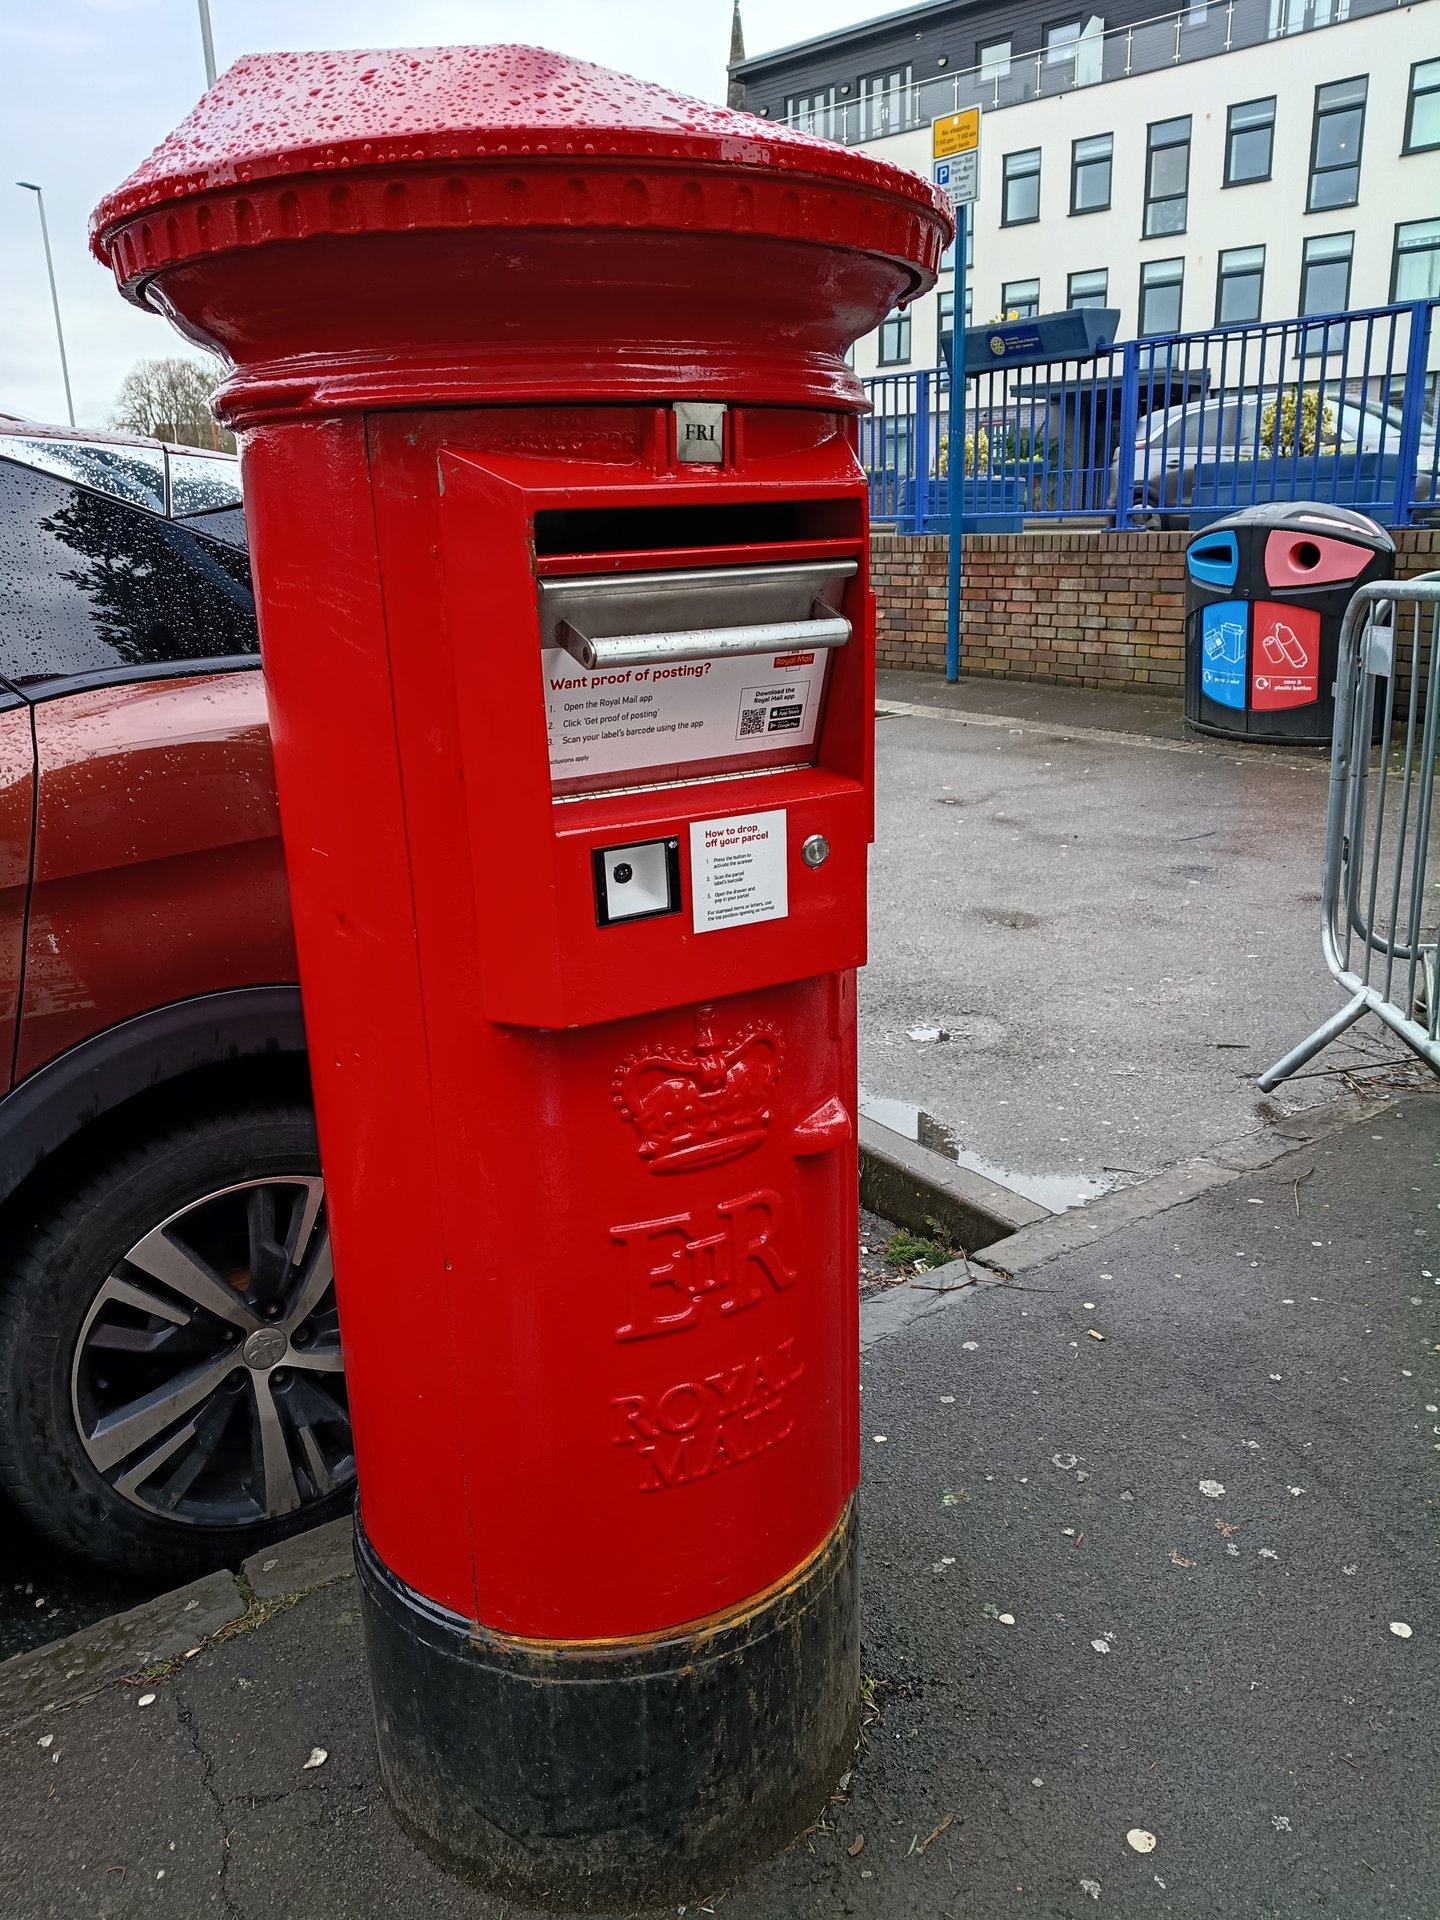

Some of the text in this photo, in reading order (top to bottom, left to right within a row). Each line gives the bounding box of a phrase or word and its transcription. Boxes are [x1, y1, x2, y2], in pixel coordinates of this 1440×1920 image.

[685, 424, 715, 441] FRI
[776, 655, 812, 666] Royal Mail
[550, 662, 712, 690] Want proof of posting?
[756, 688, 784, 697] Download
[564, 702, 584, 713] Open
[586, 700, 598, 708] the
[600, 697, 620, 708] Royal
[622, 695, 638, 704] Mail
[639, 694, 653, 703] app
[563, 718, 582, 728] Click
[600, 714, 620, 725] proof
[622, 712, 629, 720] of
[562, 736, 581, 744] Scan
[582, 734, 600, 744] your
[601, 729, 624, 740] label's
[626, 726, 655, 736] barcode
[656, 722, 676, 733] using
[678, 721, 689, 730] the
[690, 720, 704, 729] app
[550, 757, 574, 765] xclusions
[705, 830, 724, 838] How
[737, 825, 758, 834] drop
[706, 831, 768, 848] off your parcel
[609, 1337, 806, 1446] ROYAL
[638, 1398, 795, 1493] MAIL
